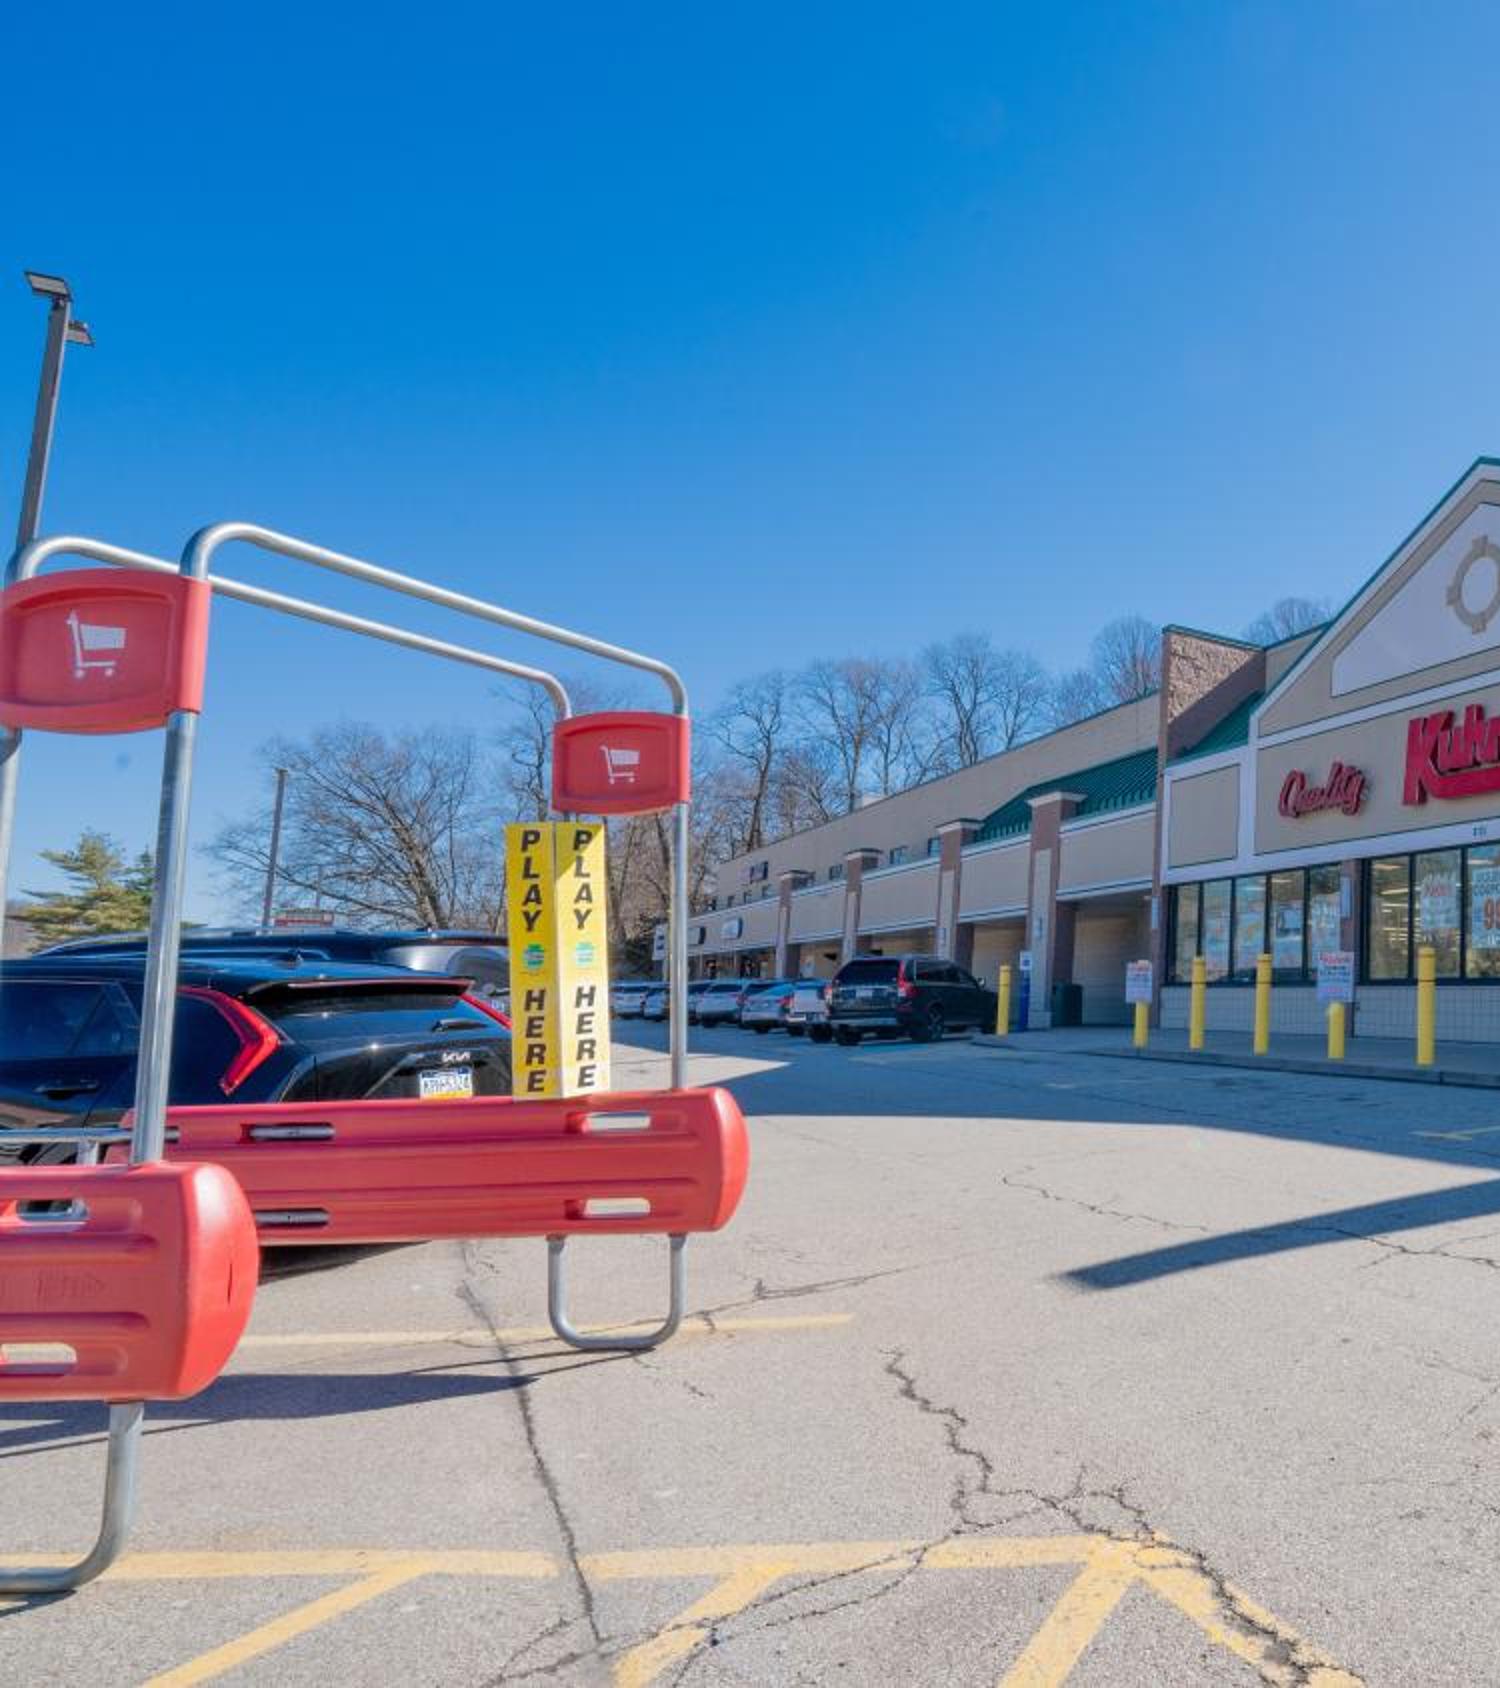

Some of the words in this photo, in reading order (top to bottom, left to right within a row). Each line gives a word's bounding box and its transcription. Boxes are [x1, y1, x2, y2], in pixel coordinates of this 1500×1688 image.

[1279, 762, 1366, 818] Quality
[521, 829, 542, 932] PLAY
[573, 829, 593, 931] PLAY
[524, 988, 546, 1093] HERE
[575, 985, 597, 1089] HERE
